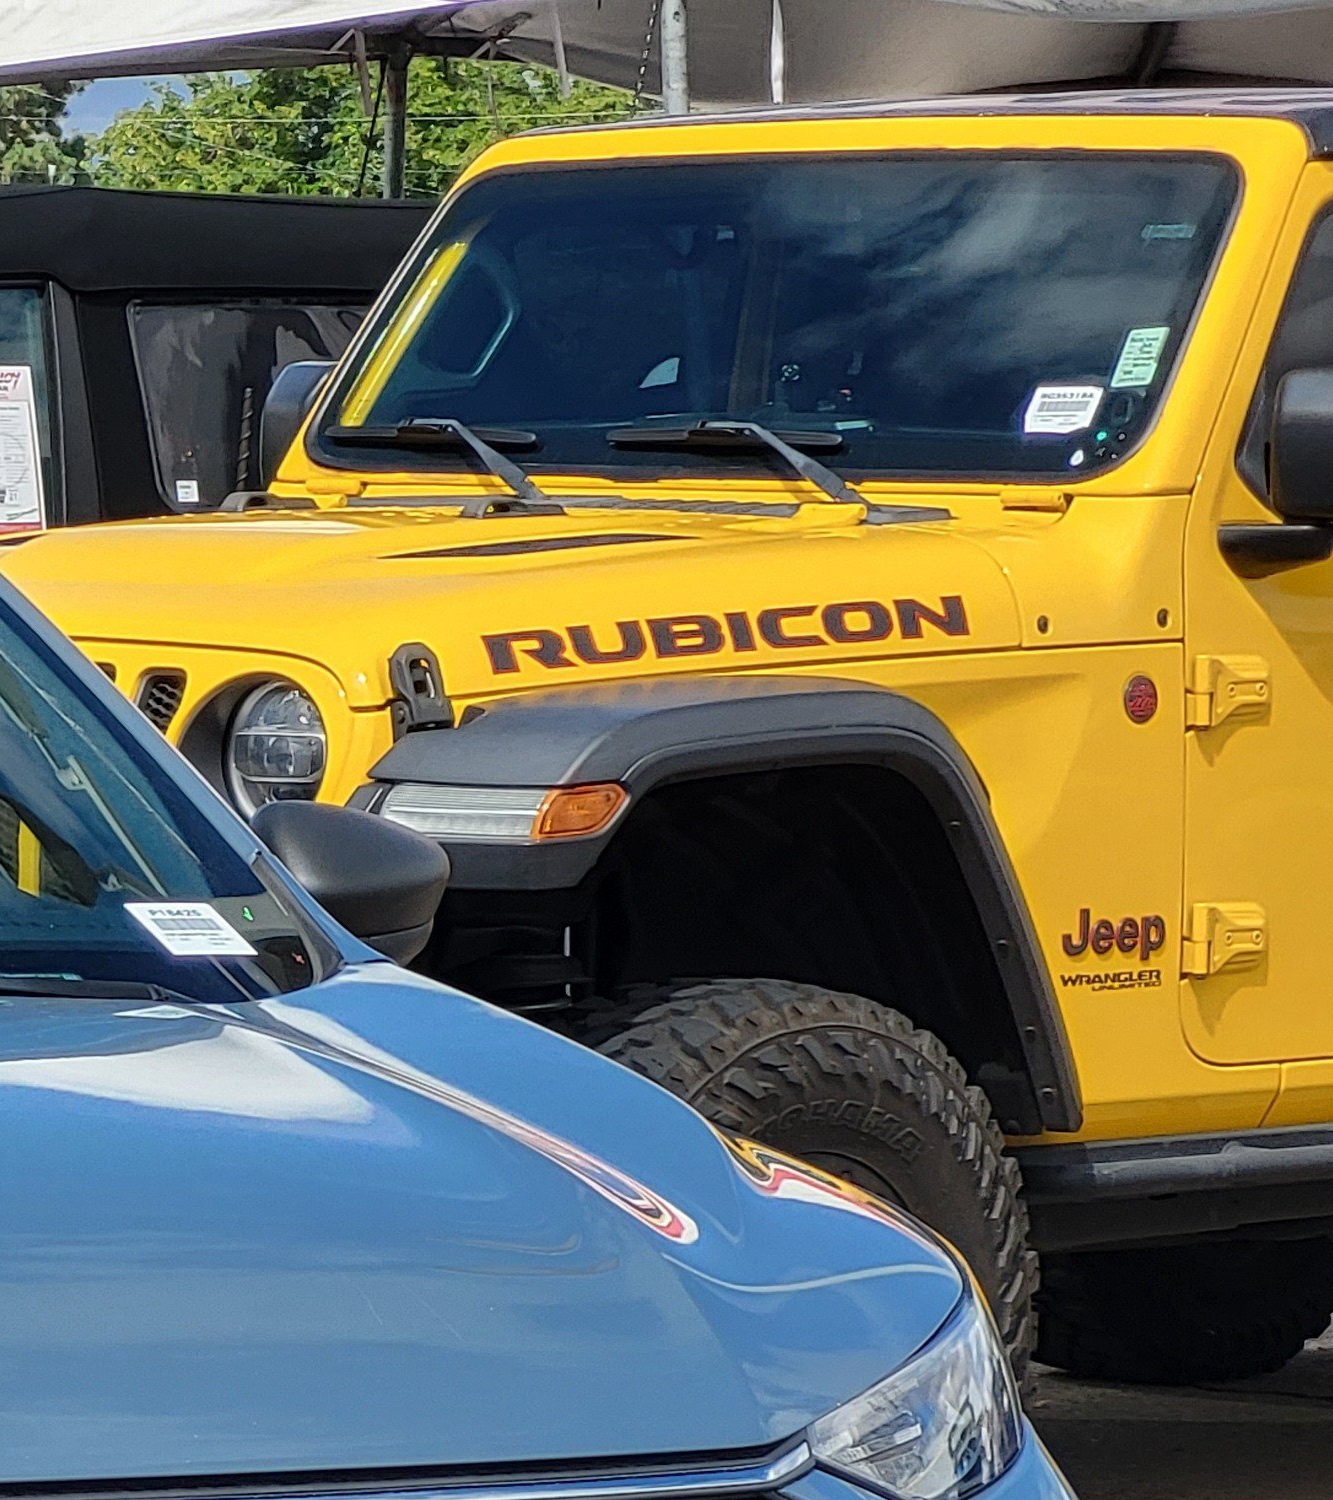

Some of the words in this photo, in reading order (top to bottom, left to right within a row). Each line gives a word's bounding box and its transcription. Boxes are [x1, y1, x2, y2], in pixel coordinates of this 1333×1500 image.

[481, 595, 971, 675] RUBICON
[1061, 908, 1166, 961] Jeep
[1059, 969, 1162, 987] WRANGLER
[1091, 980, 1162, 992] UNLIMITED
